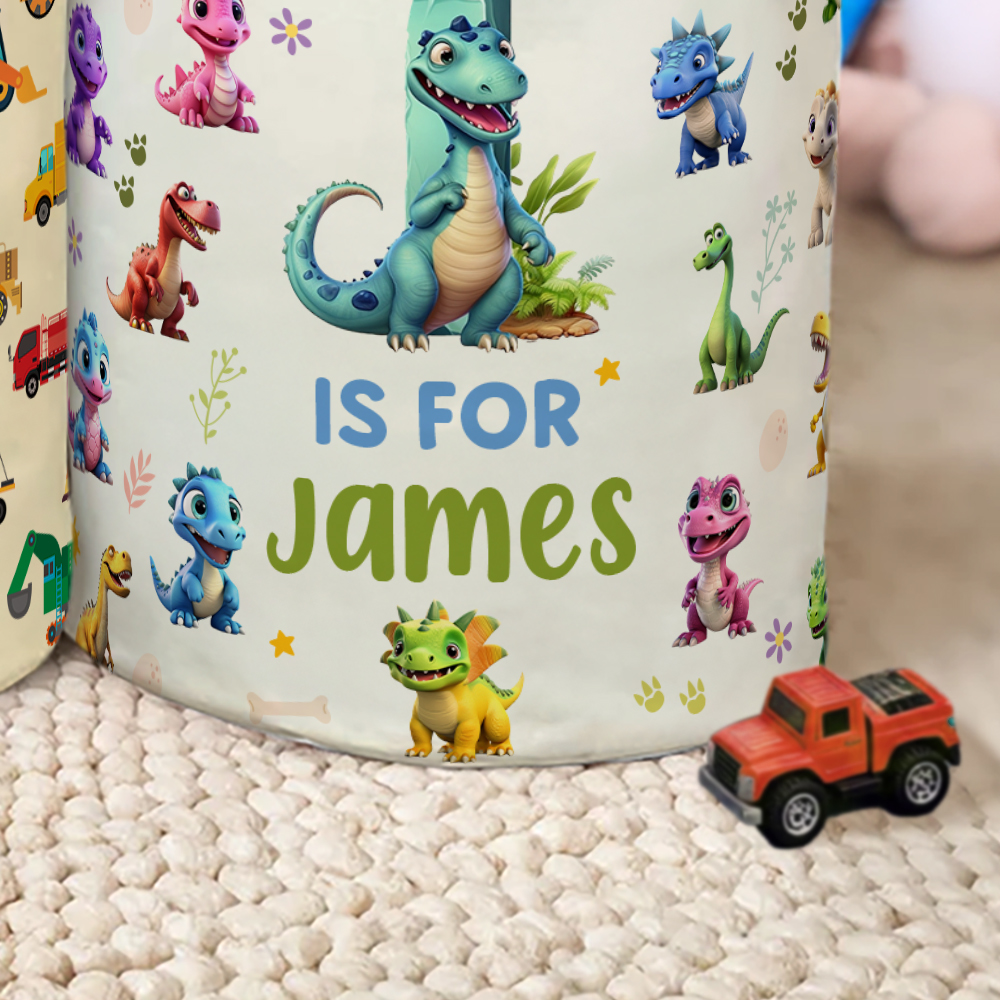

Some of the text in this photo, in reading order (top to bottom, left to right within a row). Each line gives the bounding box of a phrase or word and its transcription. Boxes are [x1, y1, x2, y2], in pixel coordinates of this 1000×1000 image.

[315, 377, 581, 450] IS FOR
[266, 476, 637, 583] James
